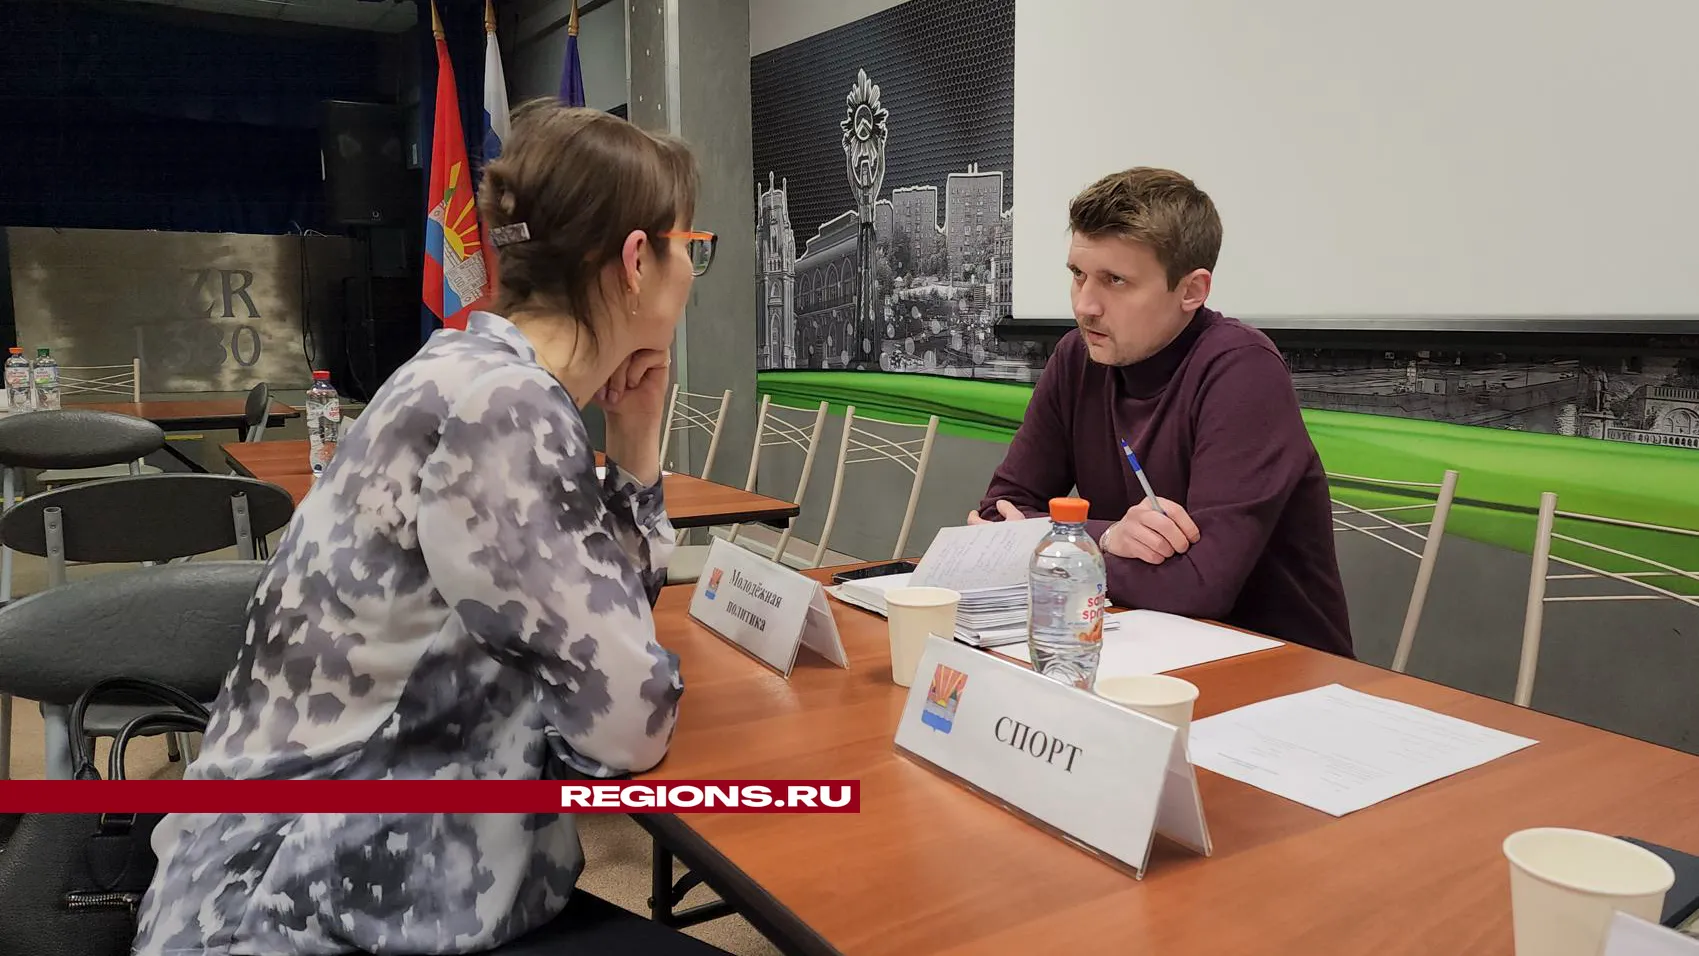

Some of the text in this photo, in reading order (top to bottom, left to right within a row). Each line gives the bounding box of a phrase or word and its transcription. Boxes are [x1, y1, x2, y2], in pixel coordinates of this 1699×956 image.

[729, 569, 783, 608] Молодёжная
[726, 600, 766, 632] политика
[994, 716, 1083, 774] СПОРТ
